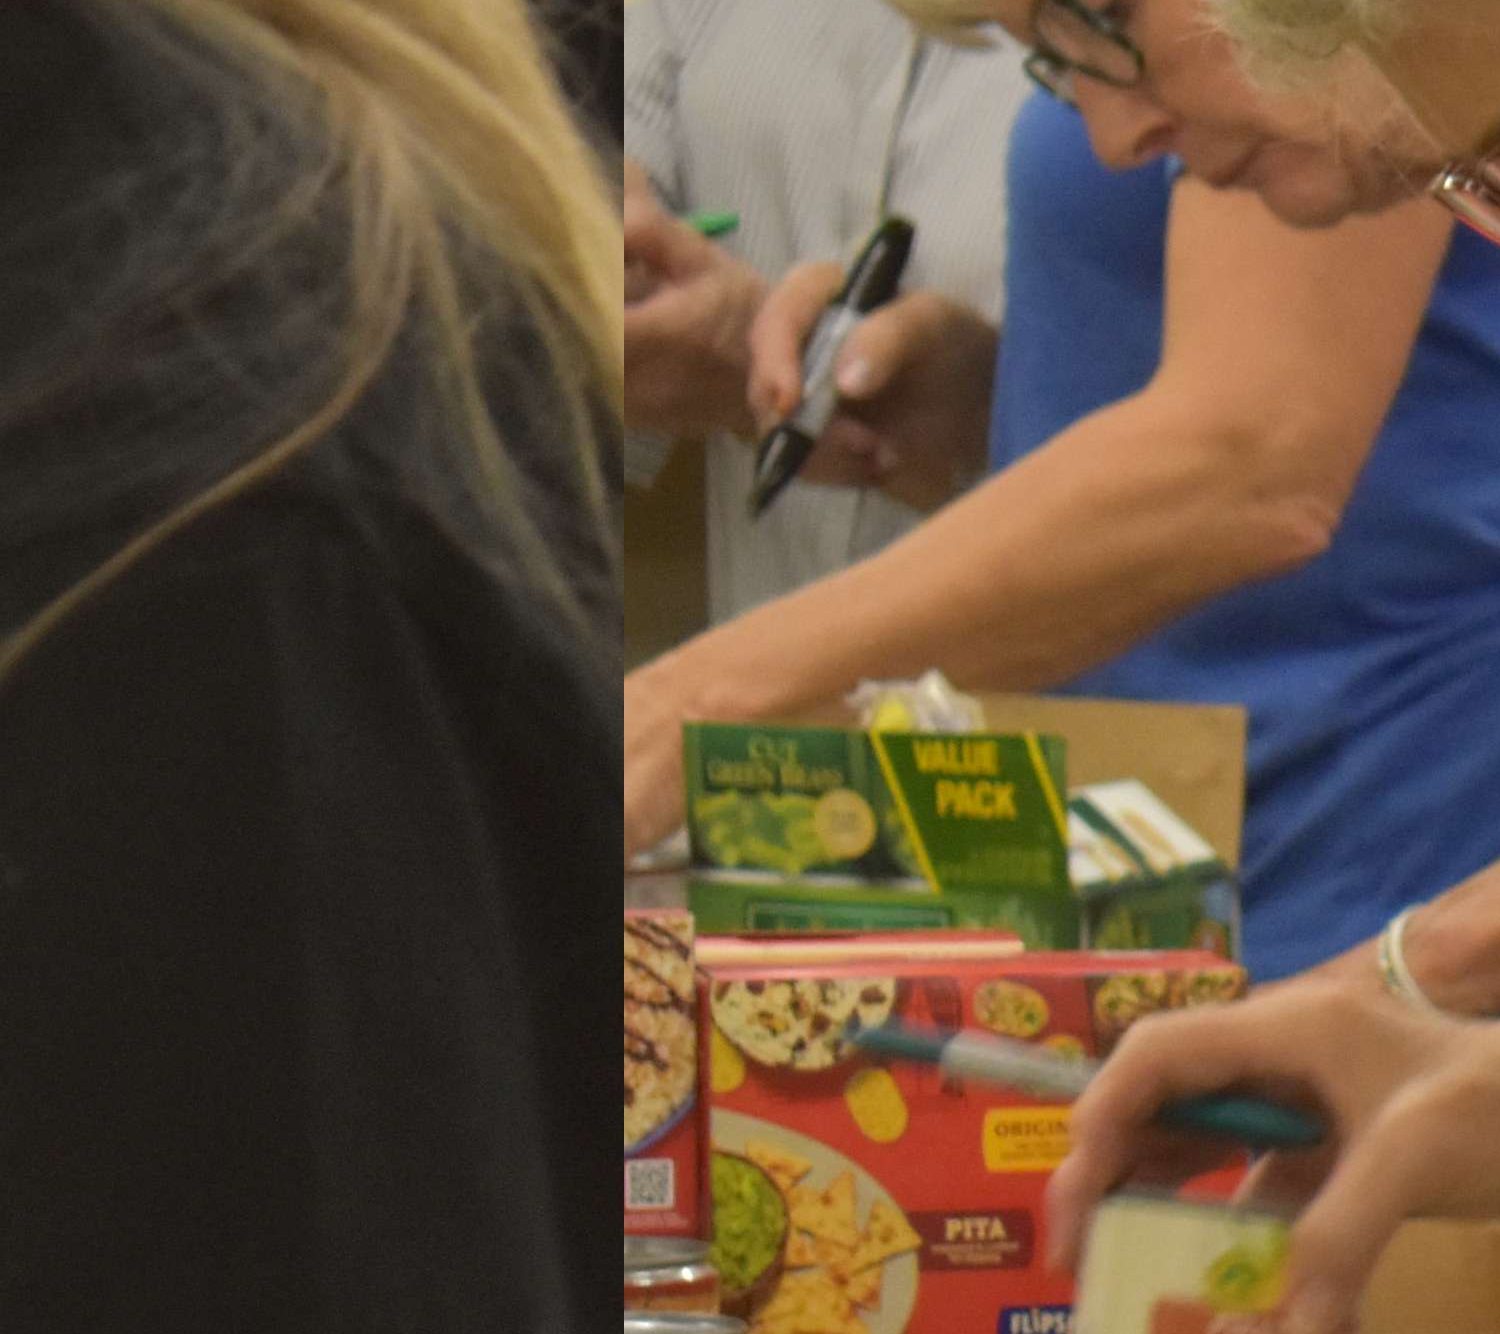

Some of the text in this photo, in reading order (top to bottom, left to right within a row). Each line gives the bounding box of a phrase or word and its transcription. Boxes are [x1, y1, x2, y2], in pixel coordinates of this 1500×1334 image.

[912, 740, 998, 776] VALUE
[936, 779, 1018, 821] PACK
[945, 1217, 1007, 1242] PITA
